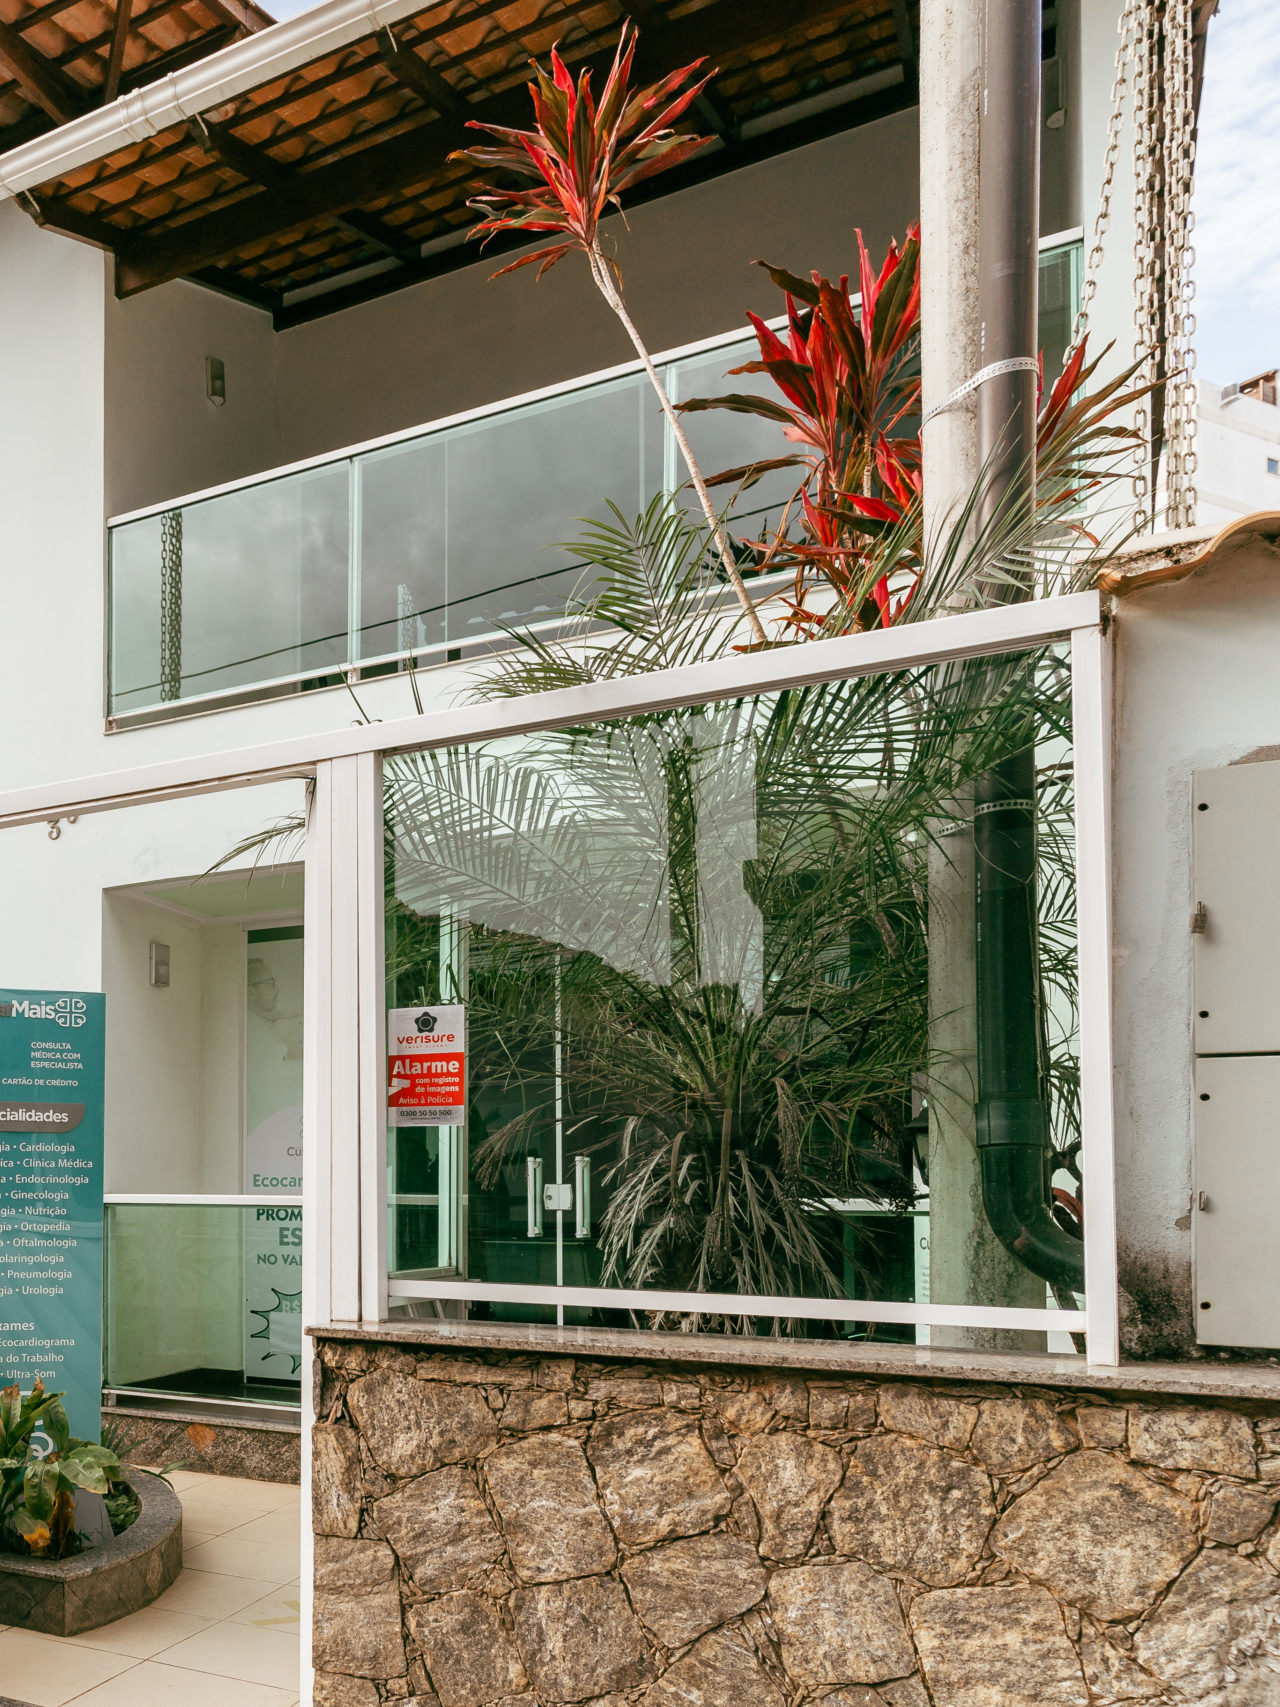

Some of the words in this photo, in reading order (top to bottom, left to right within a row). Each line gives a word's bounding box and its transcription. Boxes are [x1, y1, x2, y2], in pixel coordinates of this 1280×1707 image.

[397, 1034, 455, 1044] verisure
[31, 1042, 71, 1050] CONSULTA
[31, 1051, 61, 1059] MÉDICA
[31, 1061, 83, 1069] ESPECIALISTA
[393, 1059, 459, 1075] Alarme
[2, 1077, 32, 1085] CARTÃO
[46, 1078, 78, 1087] CRÉDITO
[432, 1076, 459, 1084] registro
[428, 1095, 452, 1103] Polícia
[20, 1142, 75, 1154] Cardiologia
[23, 1159, 55, 1168] Clínica
[58, 1159, 92, 1168] Médica
[15, 1174, 89, 1185] Endocrinologia
[11, 1190, 68, 1201] Ginecologia
[25, 1206, 67, 1217] Nutrição
[21, 1222, 70, 1233] Ortopedia
[13, 1238, 77, 1249] Oftalmologia
[257, 1254, 277, 1265] NO
[7, 1269, 72, 1280] Pneumologia
[22, 1286, 63, 1296] Urologia
[6, 1354, 19, 1362] do
[22, 1353, 64, 1362] Trabalho
[7, 1369, 56, 1379] Ultra-Som
